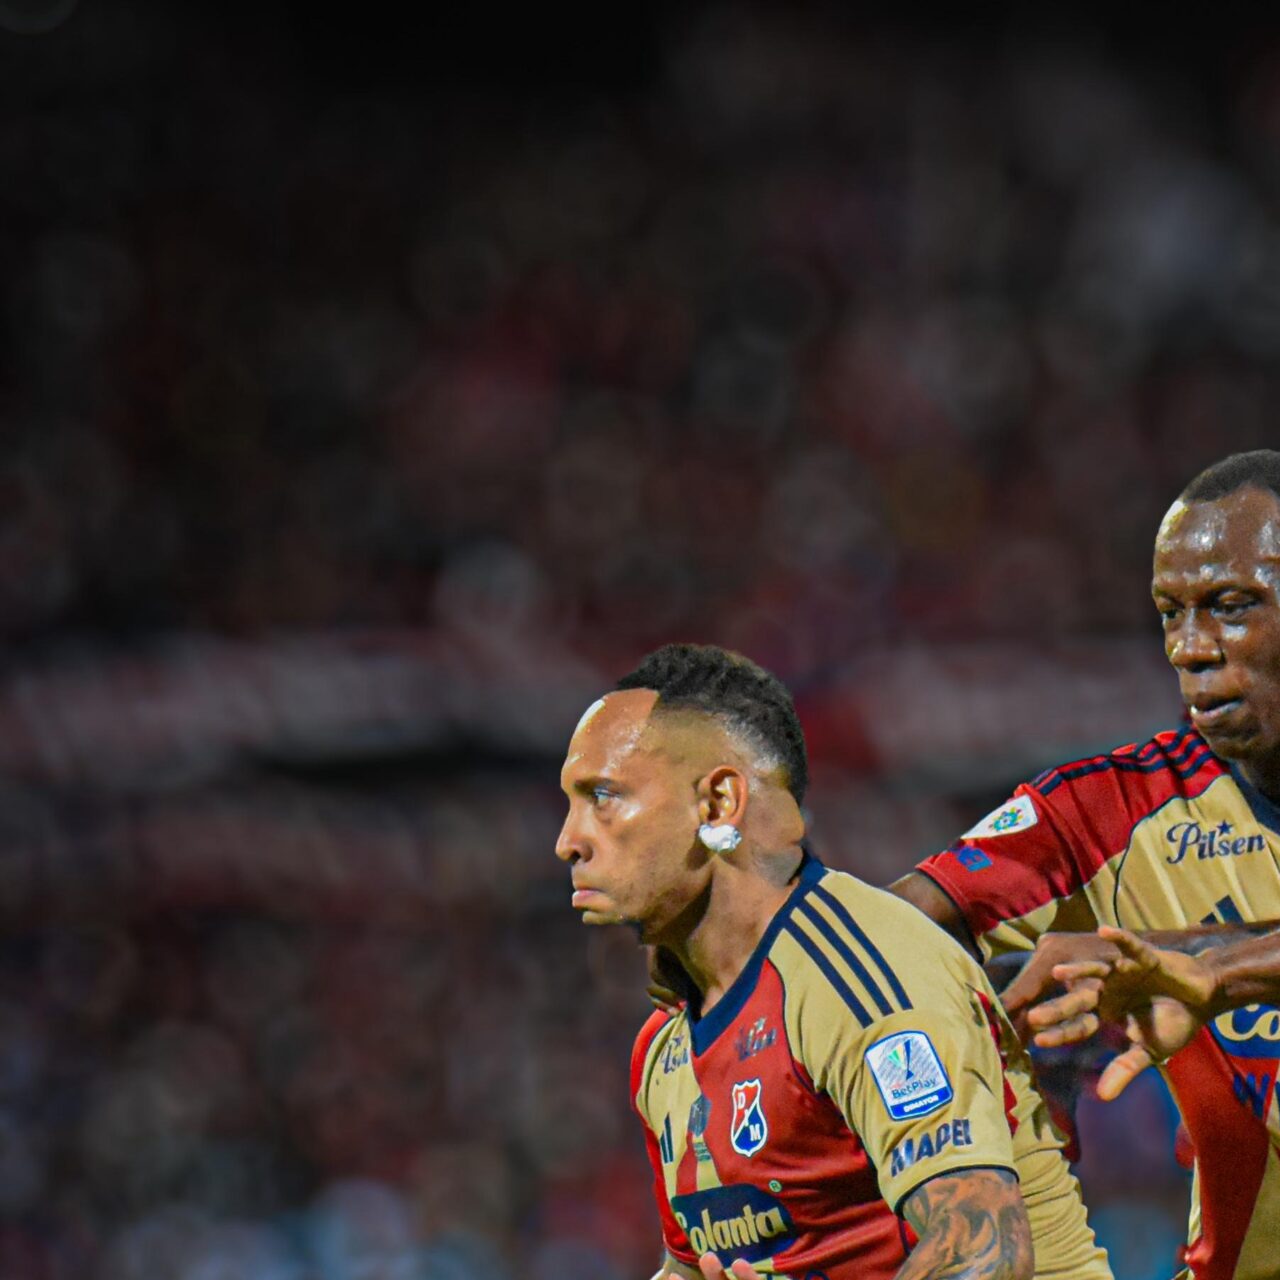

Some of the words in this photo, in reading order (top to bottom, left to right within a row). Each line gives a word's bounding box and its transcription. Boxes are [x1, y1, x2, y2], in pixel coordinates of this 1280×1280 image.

[1166, 821, 1266, 864] Pilsen
[891, 1077, 938, 1100] BetPlay
[890, 1118, 973, 1178] MAPEI
